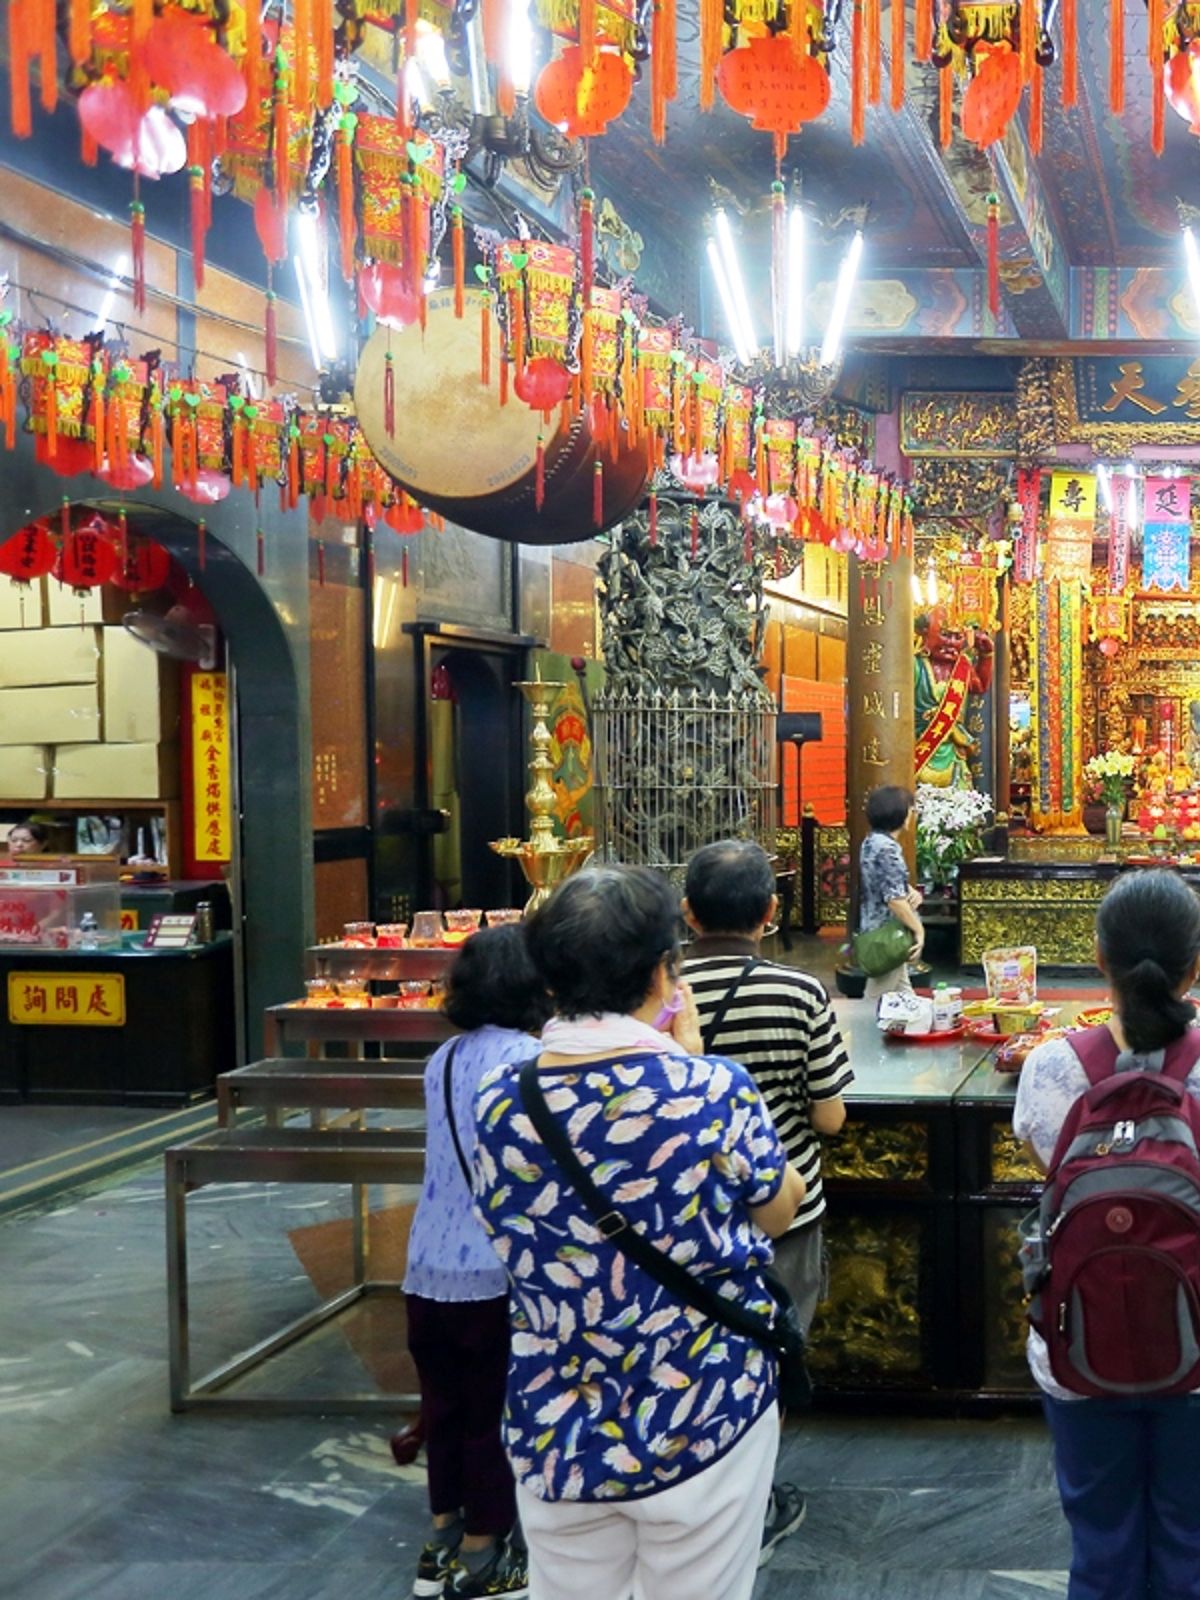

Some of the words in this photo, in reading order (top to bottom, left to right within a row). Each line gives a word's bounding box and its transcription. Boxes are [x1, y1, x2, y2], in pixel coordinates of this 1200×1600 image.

[1059, 479, 1086, 512] 壽
[1155, 483, 1182, 516] 延
[23, 984, 113, 1017] 詢問處
